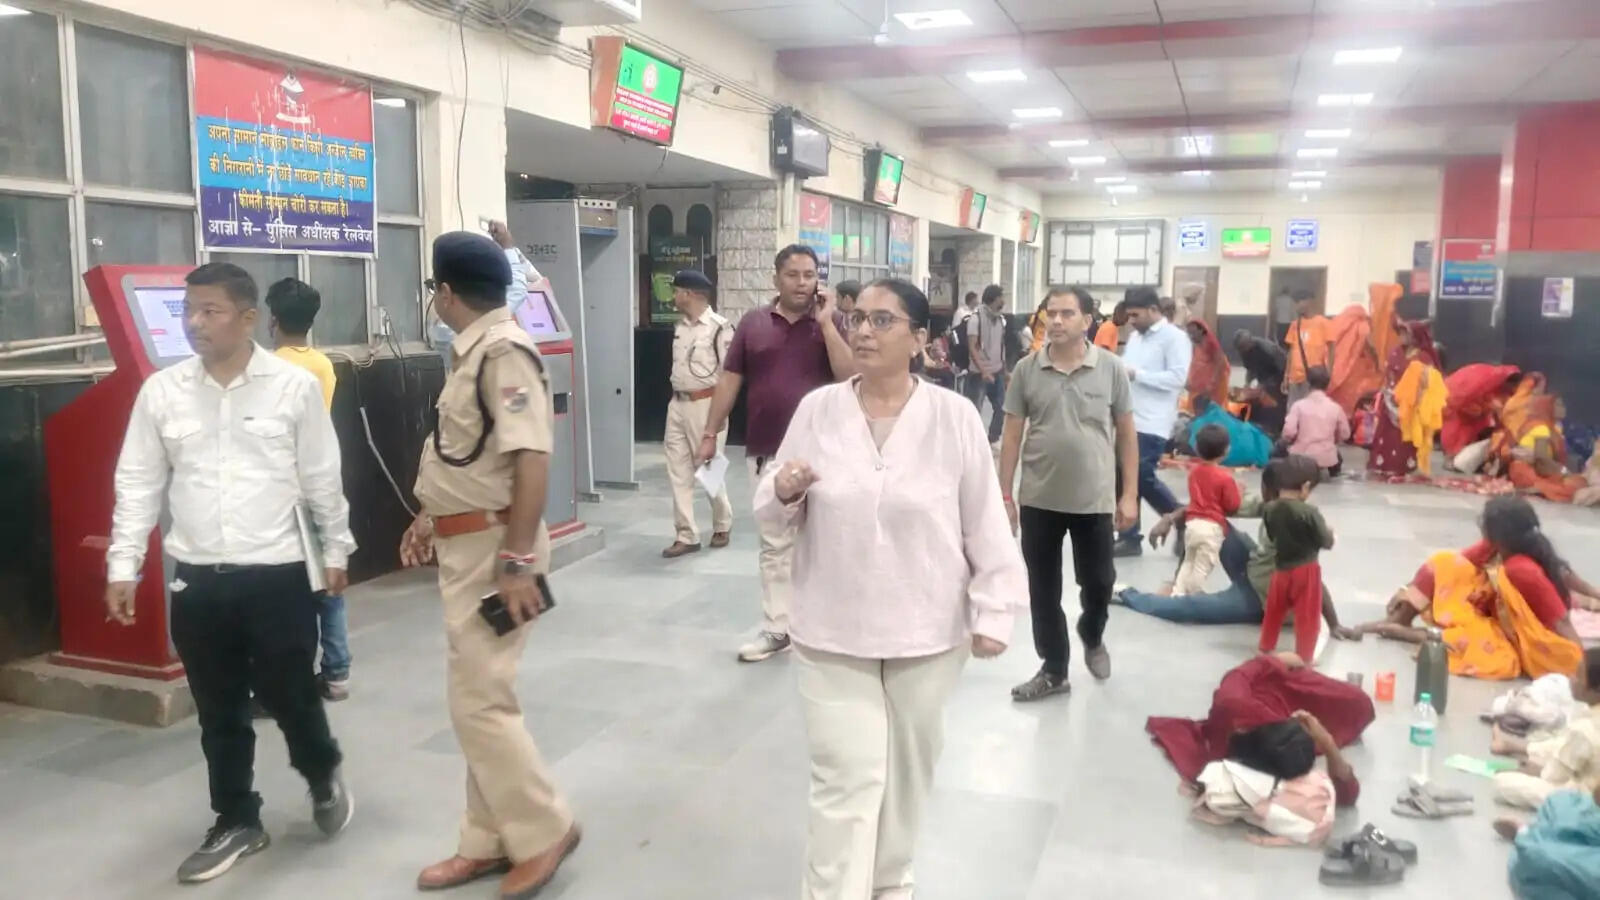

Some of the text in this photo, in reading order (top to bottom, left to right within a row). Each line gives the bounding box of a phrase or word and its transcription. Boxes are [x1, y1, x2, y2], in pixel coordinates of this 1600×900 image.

[209, 153, 220, 173] की
[239, 187, 263, 212] कीमती
[208, 219, 238, 236] आज्ञा
[266, 218, 298, 244] पुलिस
[343, 223, 373, 243] रेलवेज
